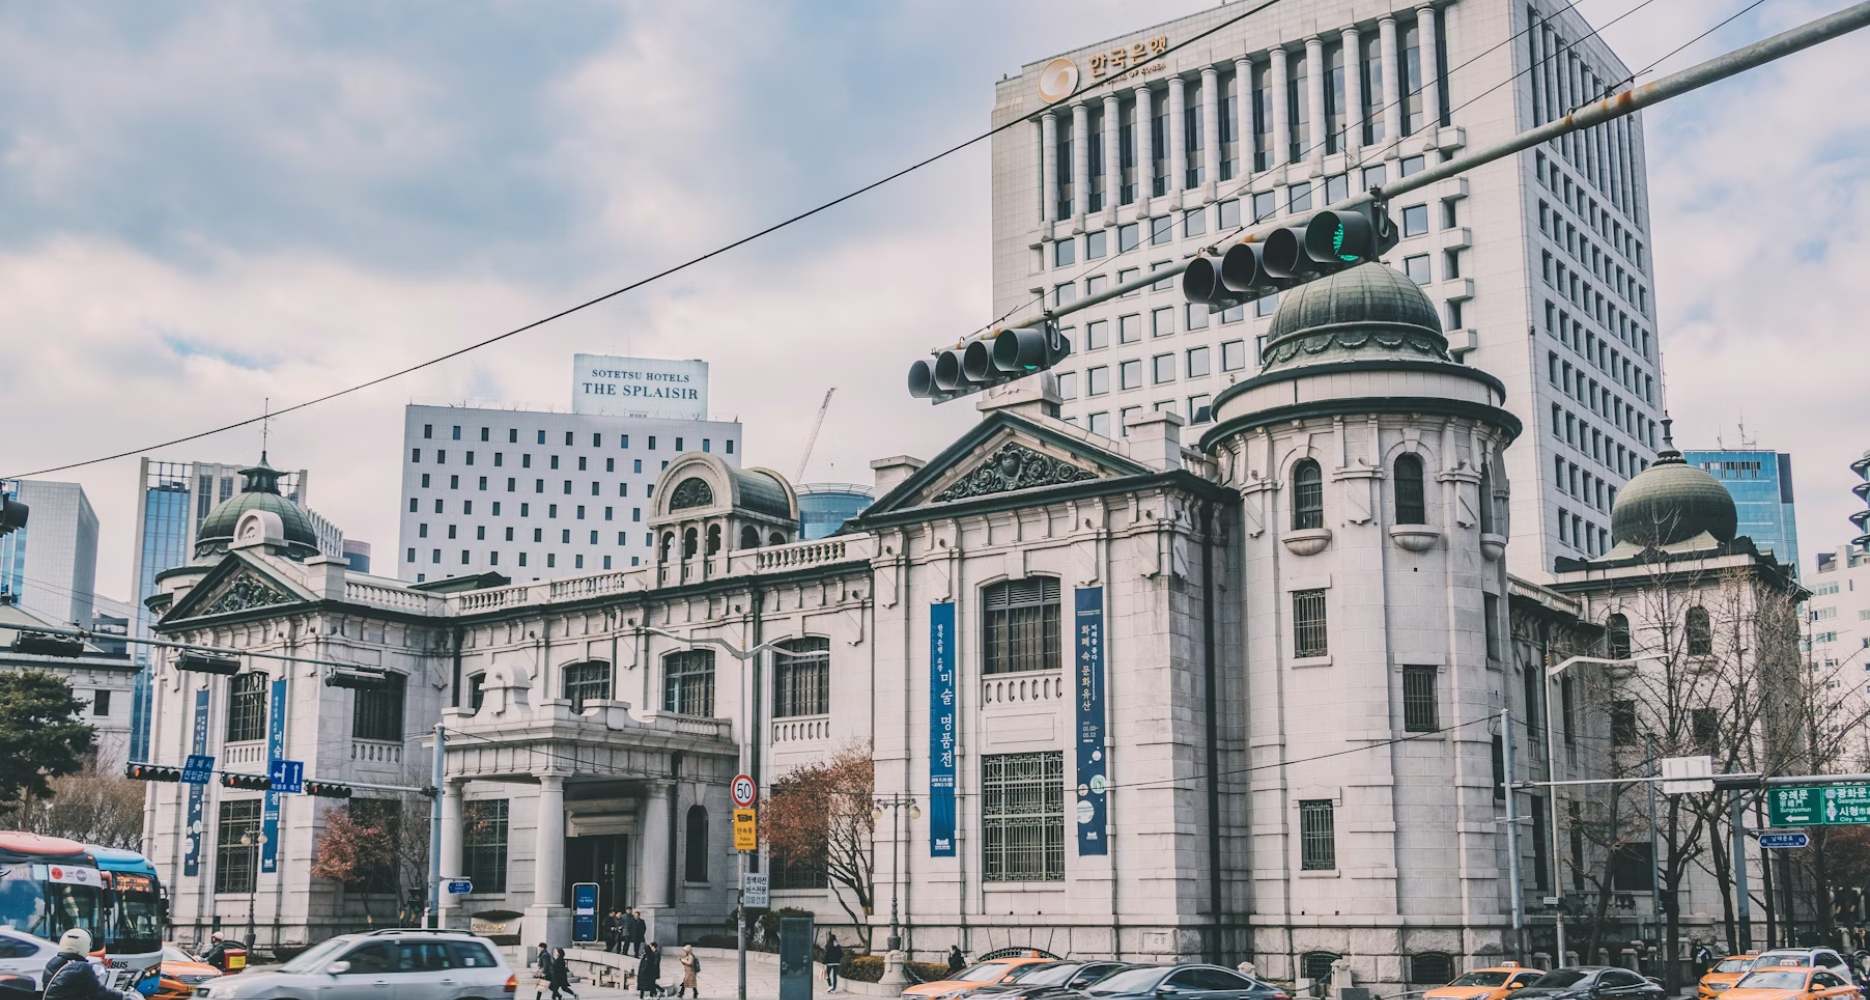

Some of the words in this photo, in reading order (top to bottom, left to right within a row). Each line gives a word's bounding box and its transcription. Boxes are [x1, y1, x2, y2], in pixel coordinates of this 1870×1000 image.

[1088, 35, 1167, 77] 한국은행
[592, 369, 642, 380] SOTETSU
[646, 372, 690, 383] HOTELS
[582, 382, 617, 396] THE
[622, 384, 699, 400] SPLAISIR
[940, 670, 954, 706] 미술
[1082, 666, 1091, 712] 문화유산
[940, 713, 954, 768] 명품전
[184, 770, 210, 781] 진입금지
[736, 783, 752, 799] 50
[1778, 790, 1808, 800] 숭례문
[1837, 788, 1867, 798] 광화문
